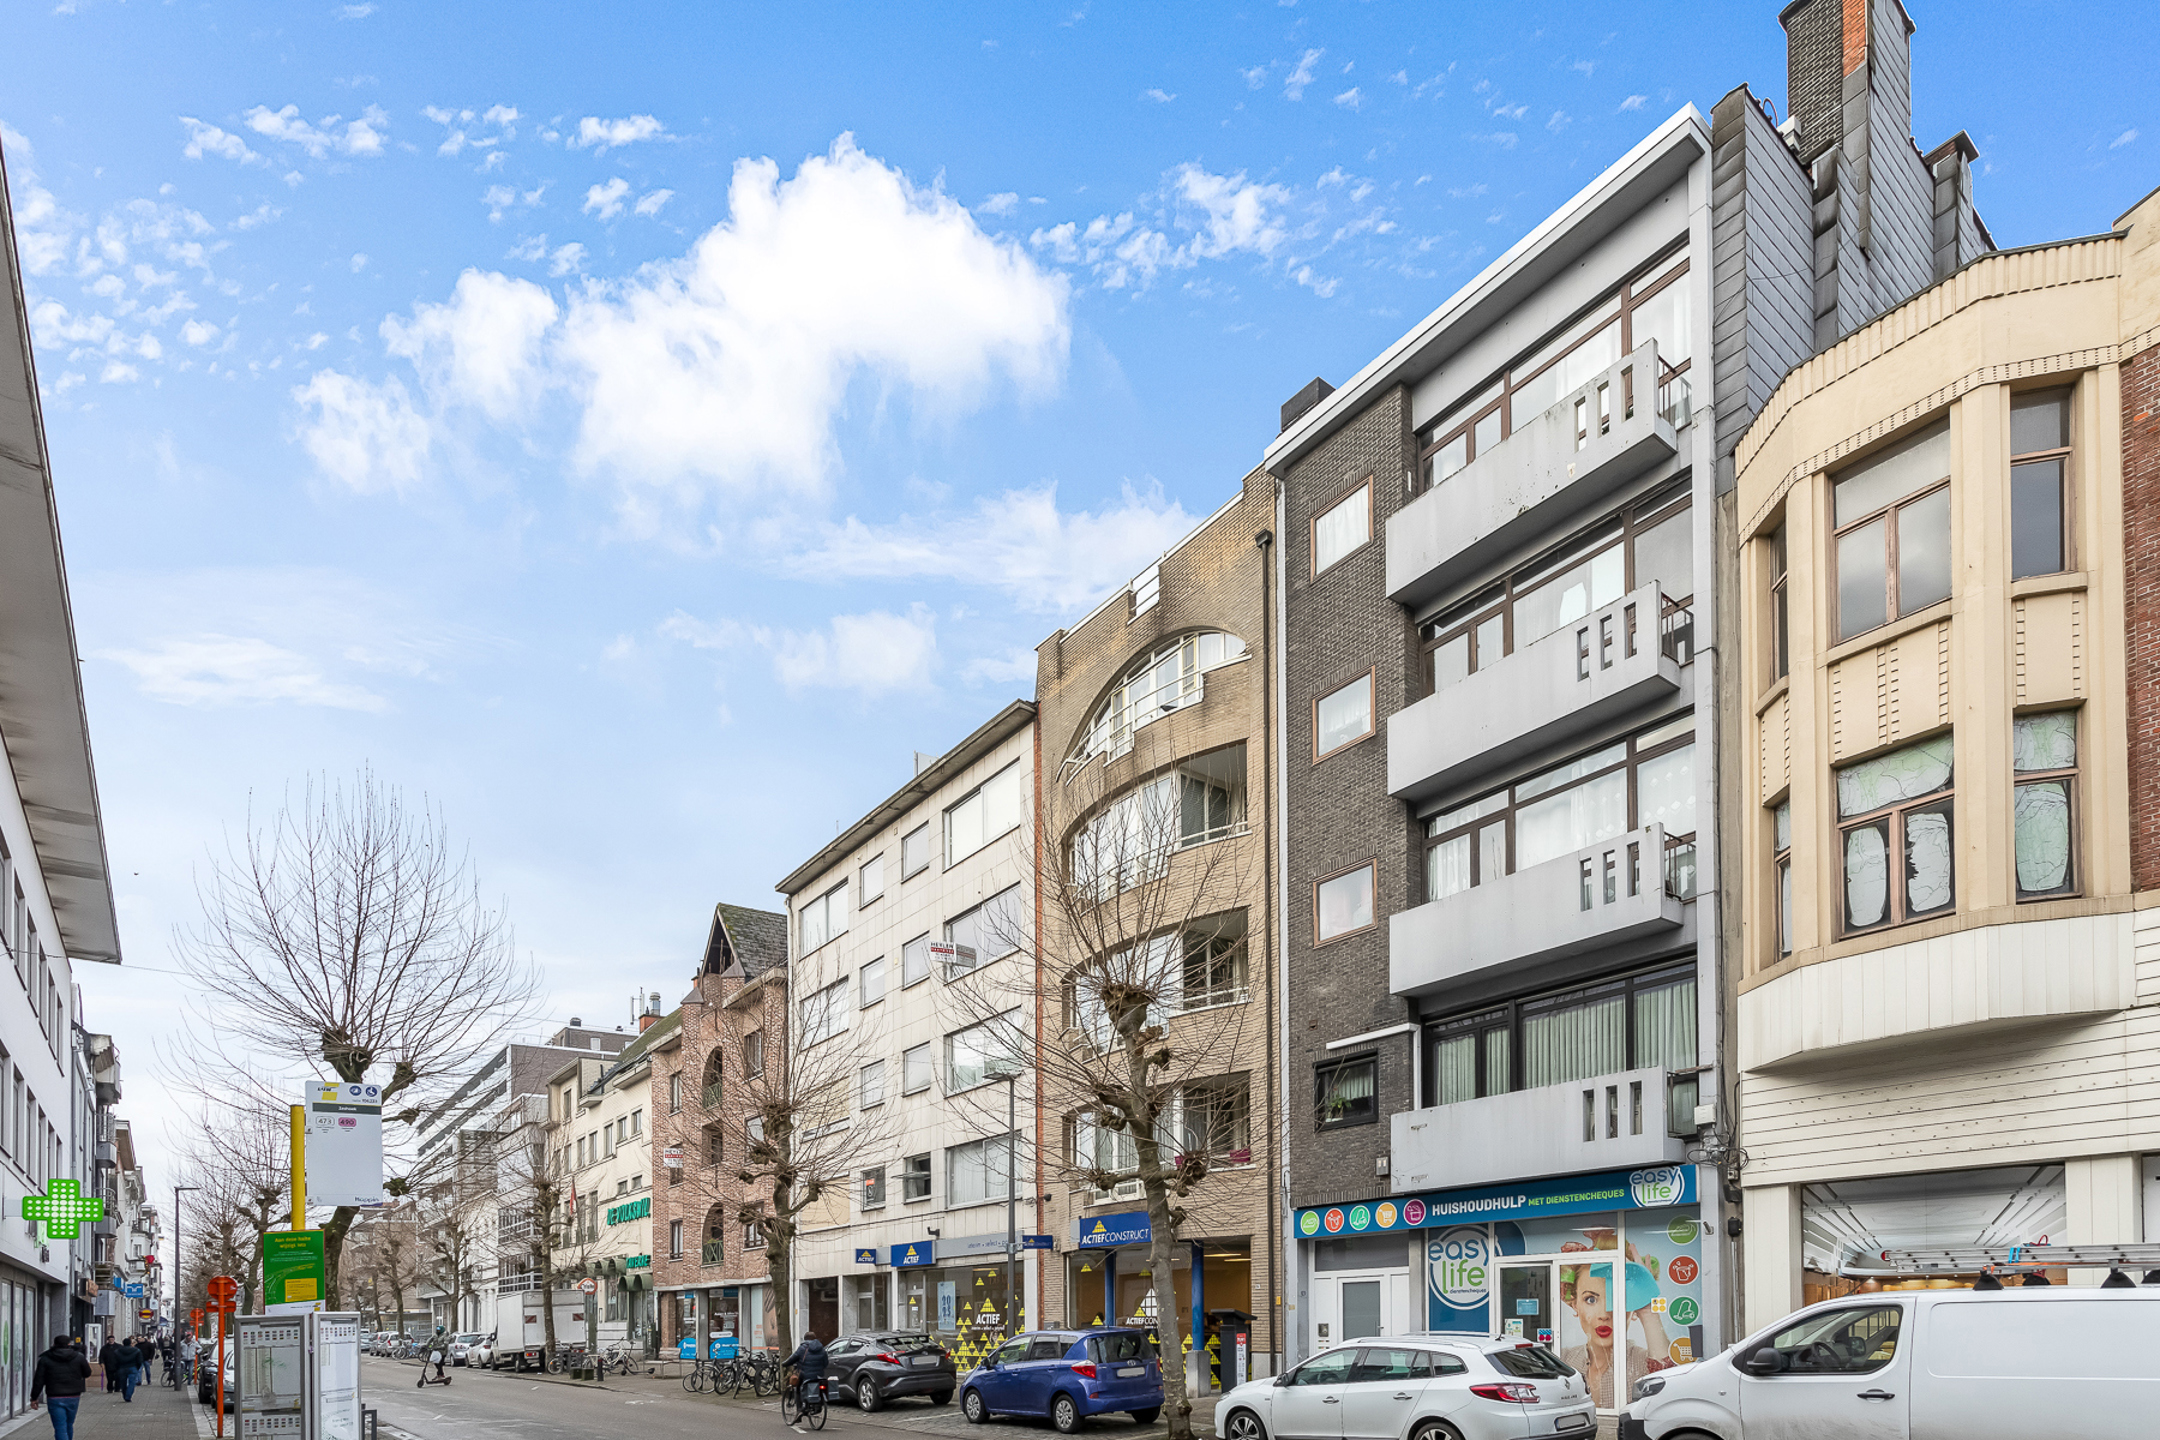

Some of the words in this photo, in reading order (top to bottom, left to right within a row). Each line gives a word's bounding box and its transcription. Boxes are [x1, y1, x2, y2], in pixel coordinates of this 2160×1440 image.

[1631, 1168, 1679, 1187] easy
[1432, 1195, 1526, 1217] HUISHOUDHULP
[1528, 1197, 1544, 1207] MET
[1546, 1188, 1625, 1205] DIENSTENCHEQUES
[1641, 1181, 1672, 1204] life
[903, 1255, 920, 1265] ACTIEF
[1428, 1239, 1489, 1267] easy
[1442, 1259, 1486, 1294] life
[975, 1313, 1000, 1325] ACTIEF
